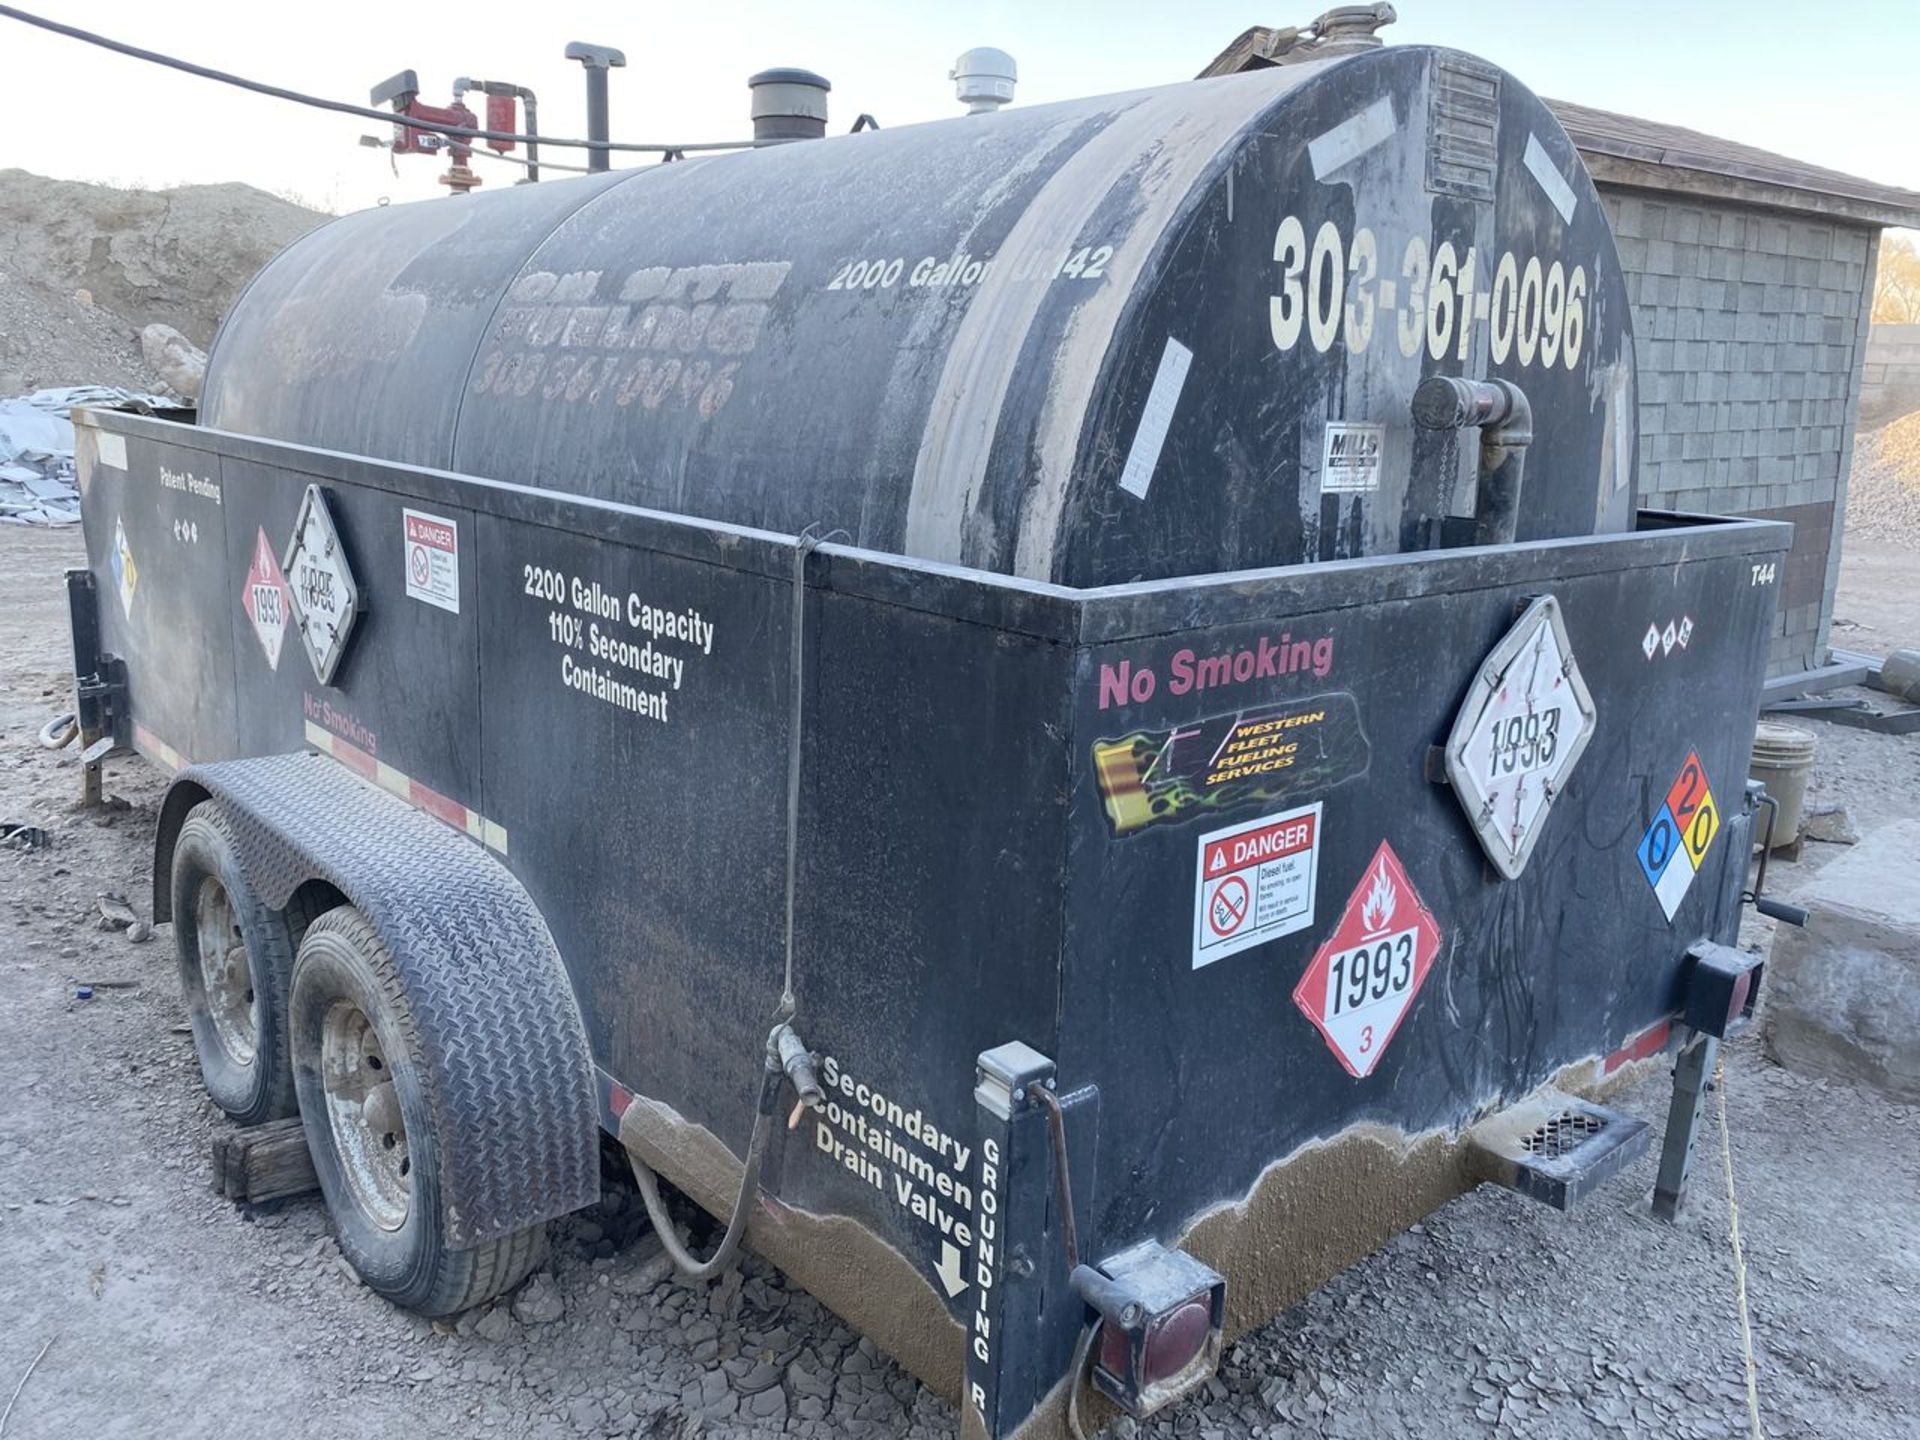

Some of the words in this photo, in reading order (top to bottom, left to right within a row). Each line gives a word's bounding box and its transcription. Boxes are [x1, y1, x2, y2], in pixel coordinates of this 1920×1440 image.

[827, 257, 904, 290] 2000
[1270, 215, 1586, 370] 303-361-0096
[160, 466, 186, 491] Patent
[187, 472, 221, 505] Pending
[418, 524, 451, 545] DANGER
[1752, 563, 1775, 586] T44
[255, 586, 281, 625] 1993
[524, 564, 565, 604] 2200
[571, 576, 620, 622] Gallon
[627, 592, 714, 655] Capacity
[549, 611, 583, 650] 110%
[590, 623, 684, 690] Secondary
[1098, 660, 1155, 710] No
[1169, 633, 1333, 696] Smoking
[562, 654, 668, 723] Containment
[304, 691, 320, 718] No
[323, 701, 376, 755] Smoking
[1227, 733, 1283, 753] FLEET
[1237, 711, 1325, 738] WESTERN
[1206, 756, 1295, 785] SERVICES
[1217, 742, 1298, 768] FUELING
[1677, 763, 1697, 816] 2
[1233, 824, 1308, 864] DANGER
[1648, 818, 1671, 872] 0
[1693, 805, 1712, 855] 0
[1261, 864, 1281, 880] Diesel
[1332, 933, 1413, 1015] 1993
[1359, 1025, 1373, 1053] 3
[823, 1056, 971, 1172] Secondary
[816, 1121, 884, 1190] Drain
[894, 1173, 972, 1247] Valve
[974, 1138, 999, 1364] GROUNDING
